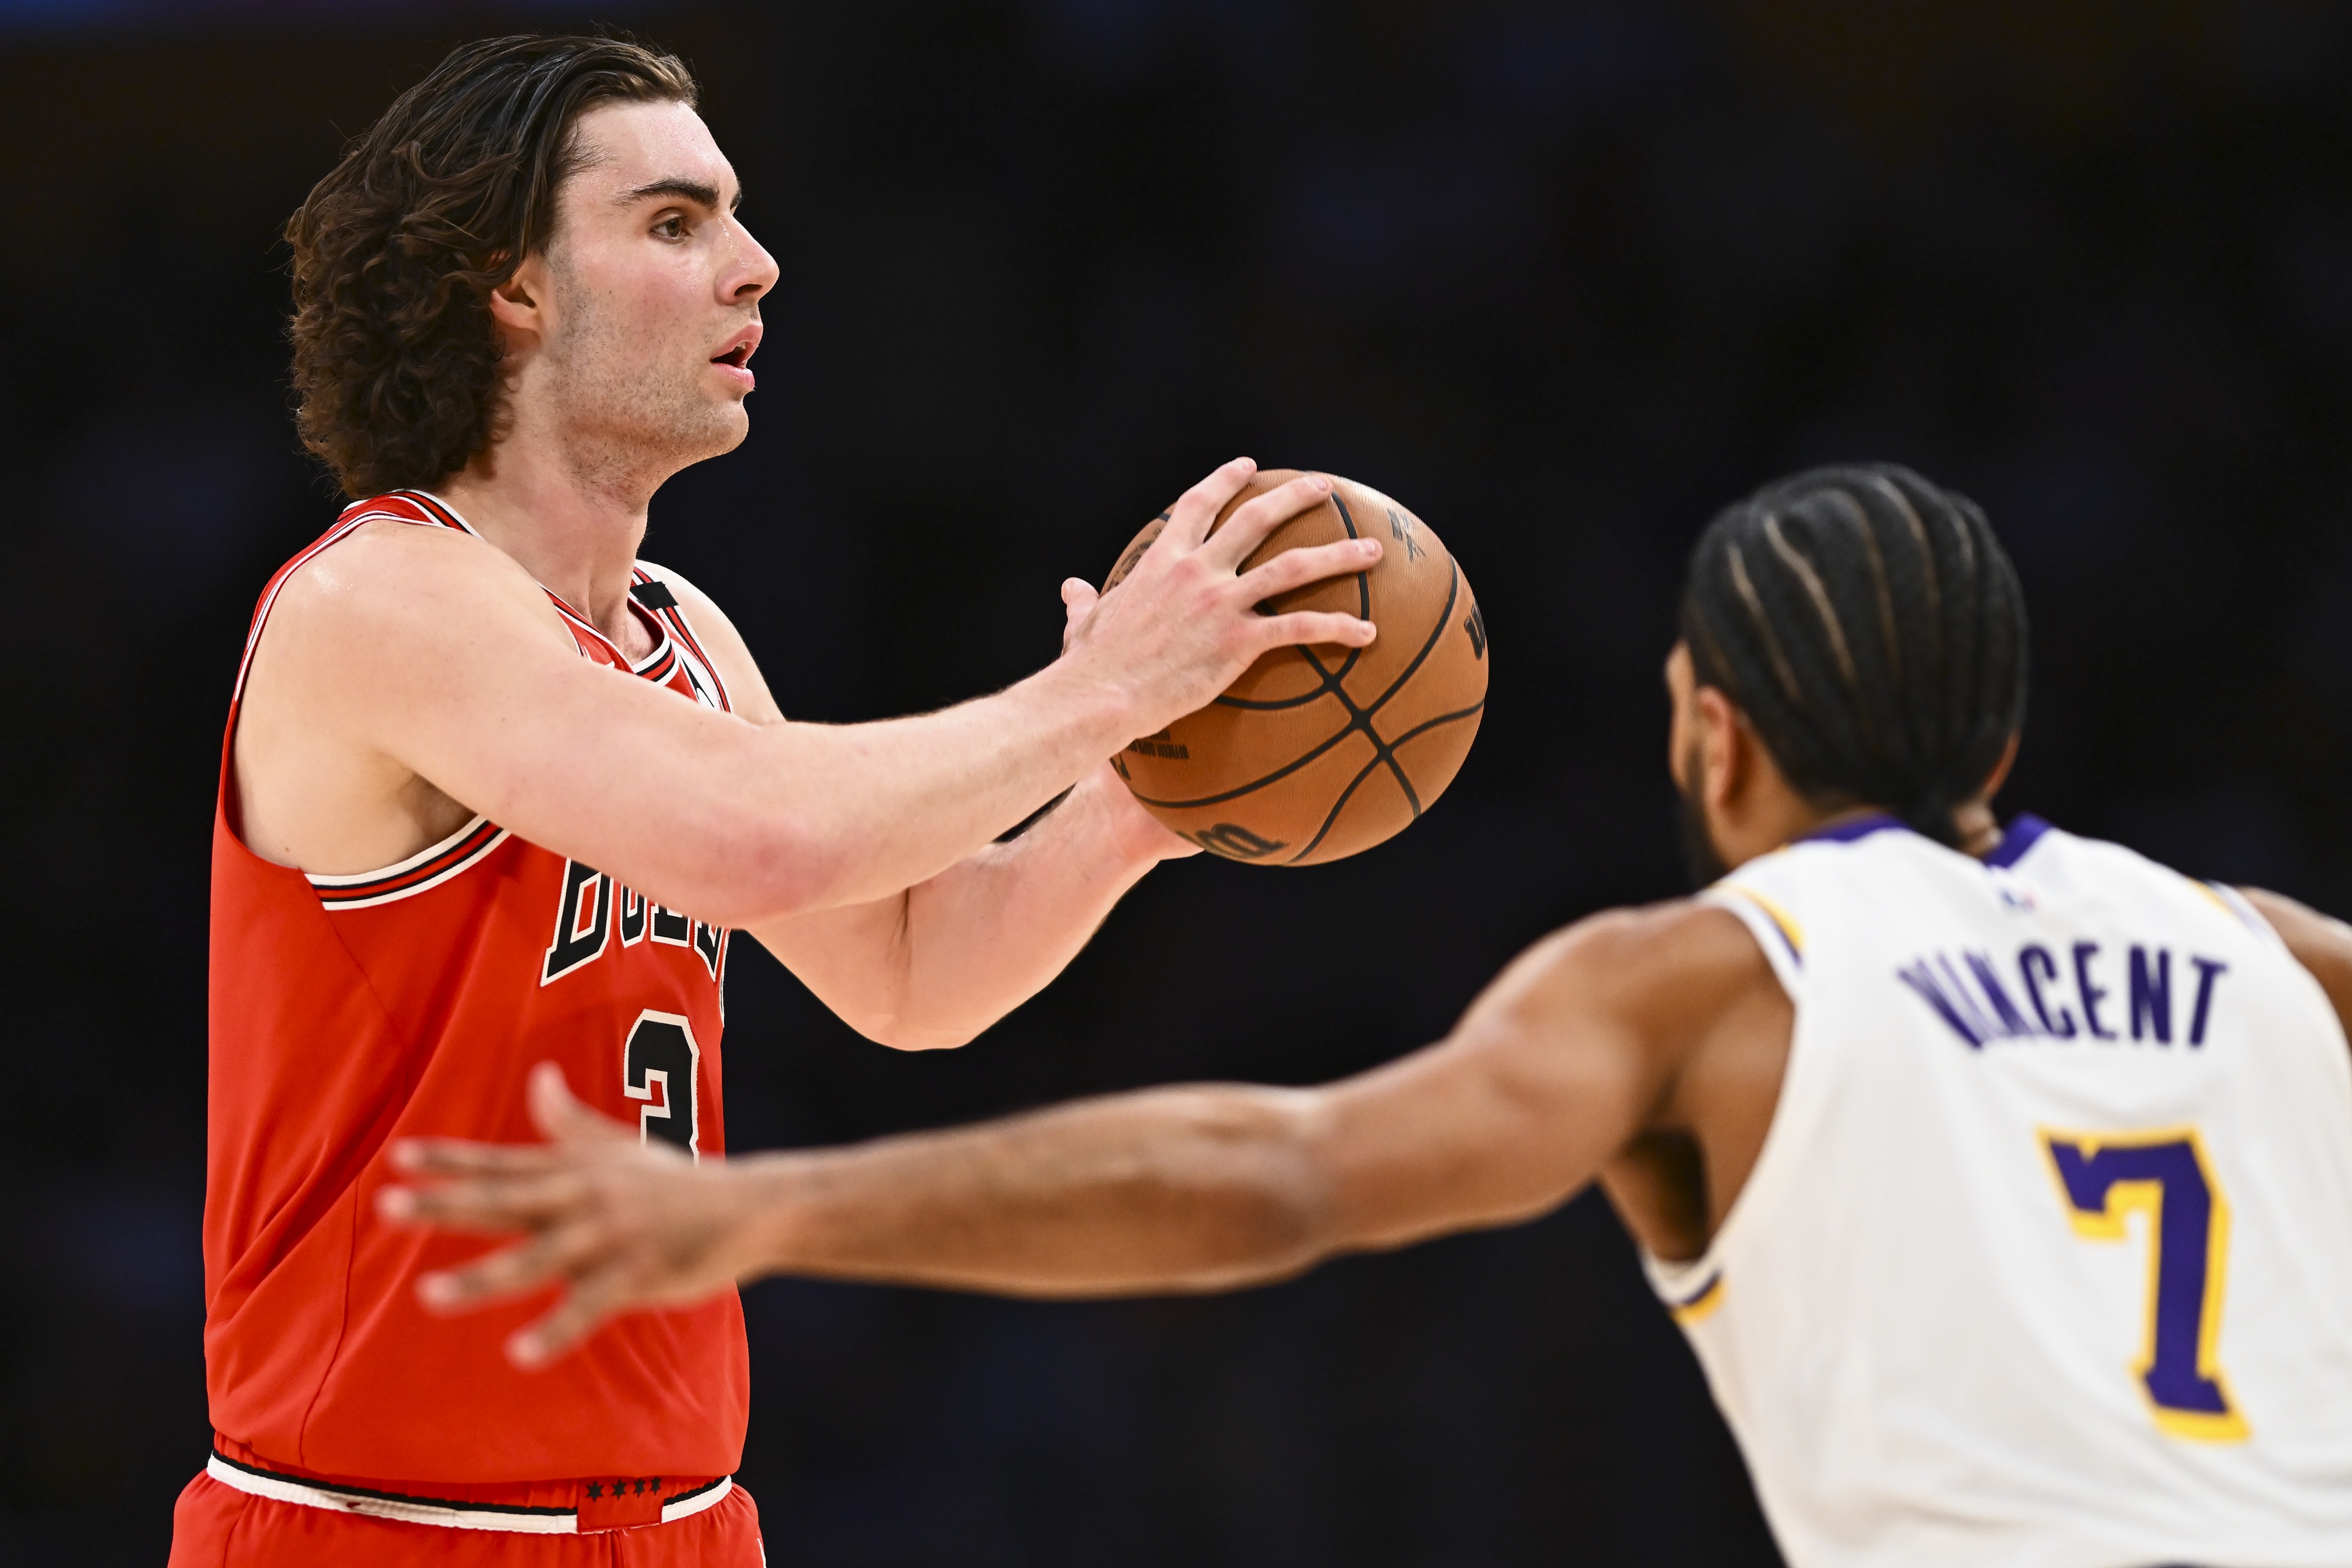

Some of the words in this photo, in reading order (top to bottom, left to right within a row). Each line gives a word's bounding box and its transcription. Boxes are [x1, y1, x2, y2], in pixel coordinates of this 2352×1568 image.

[1897, 939, 2230, 1049] VINCENT
[623, 1008, 700, 1169] 3
[2034, 1124, 2254, 1444] 7
